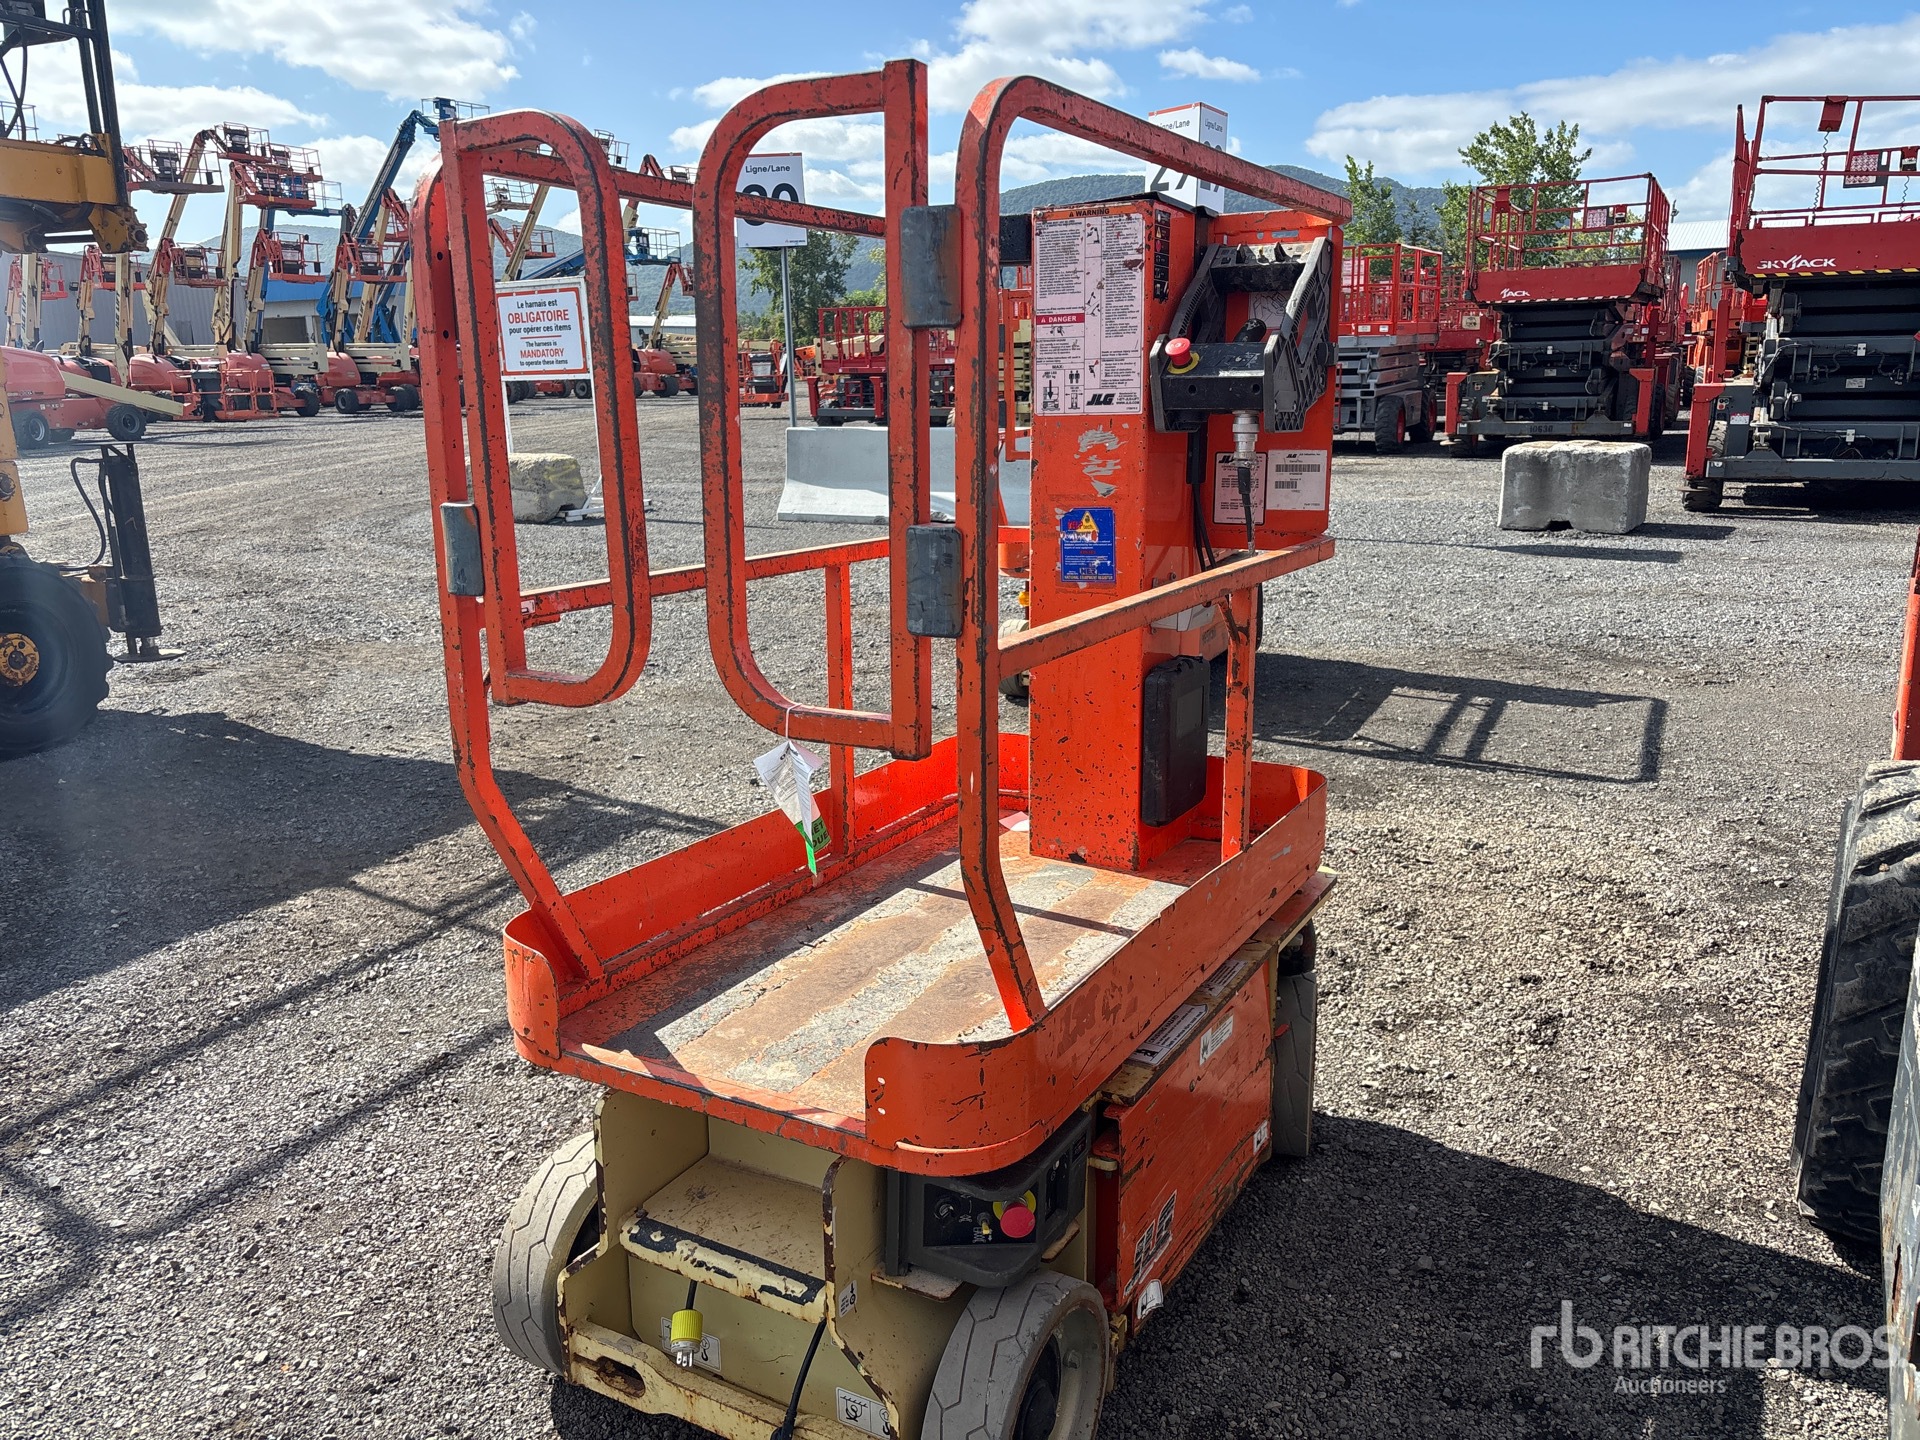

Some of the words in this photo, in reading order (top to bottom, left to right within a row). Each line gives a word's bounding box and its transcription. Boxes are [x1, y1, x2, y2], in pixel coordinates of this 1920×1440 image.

[745, 165, 791, 174] Ligne/Lane
[1076, 208, 1110, 217] WARNING
[517, 301, 524, 309] Le
[525, 300, 546, 308] harnais
[507, 309, 569, 324] OBLIGATOIRE
[1048, 315, 1077, 323] DANGER
[509, 327, 522, 336] pour
[523, 325, 542, 335] opérer
[554, 323, 572, 332] items
[520, 348, 565, 359] MANDATORY
[1086, 393, 1116, 406] JLG
